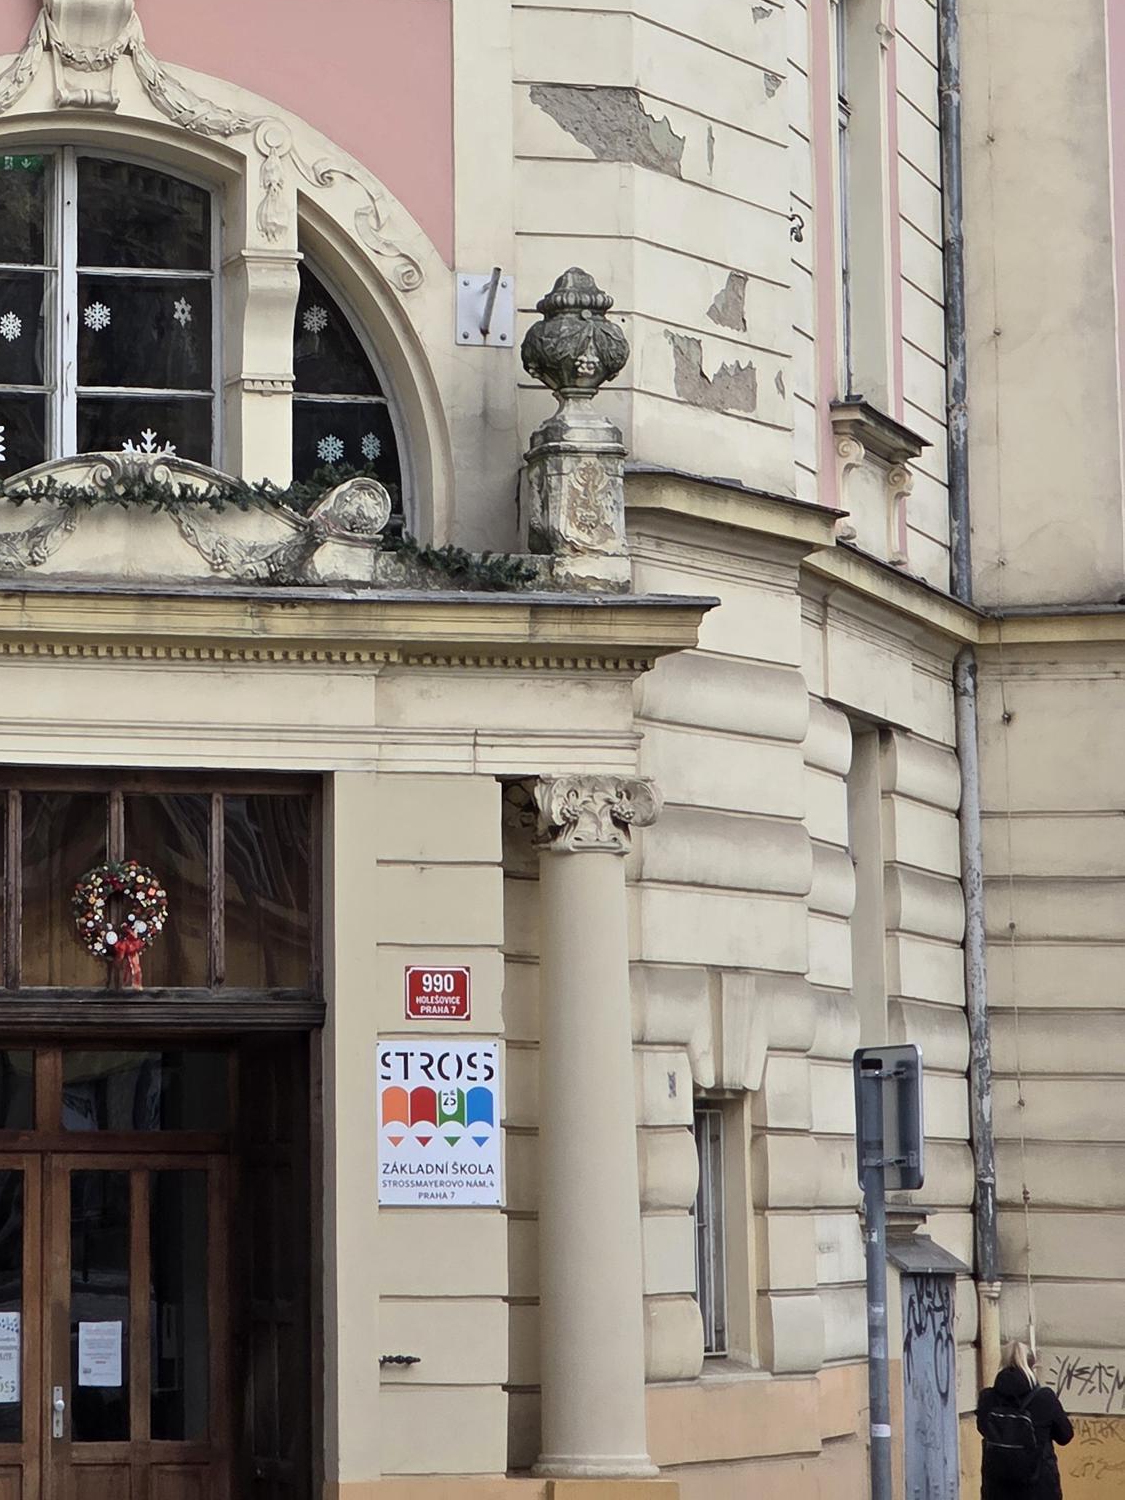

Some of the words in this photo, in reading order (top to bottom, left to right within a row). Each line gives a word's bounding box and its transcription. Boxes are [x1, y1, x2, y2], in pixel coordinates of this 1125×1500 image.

[422, 973, 455, 993] 990
[415, 995, 461, 1005] HOLEŠOVICE
[420, 1005, 450, 1015] PRAHA
[451, 1005, 457, 1014] 7
[380, 1051, 495, 1082] STROSS
[382, 1160, 449, 1175] ZÁKLADNÍ
[451, 1161, 495, 1175] ŠKOLA
[382, 1180, 464, 1189] STROSSMAYEROVO
[418, 1191, 449, 1200] PRAHA
[449, 1191, 456, 1200] 7
